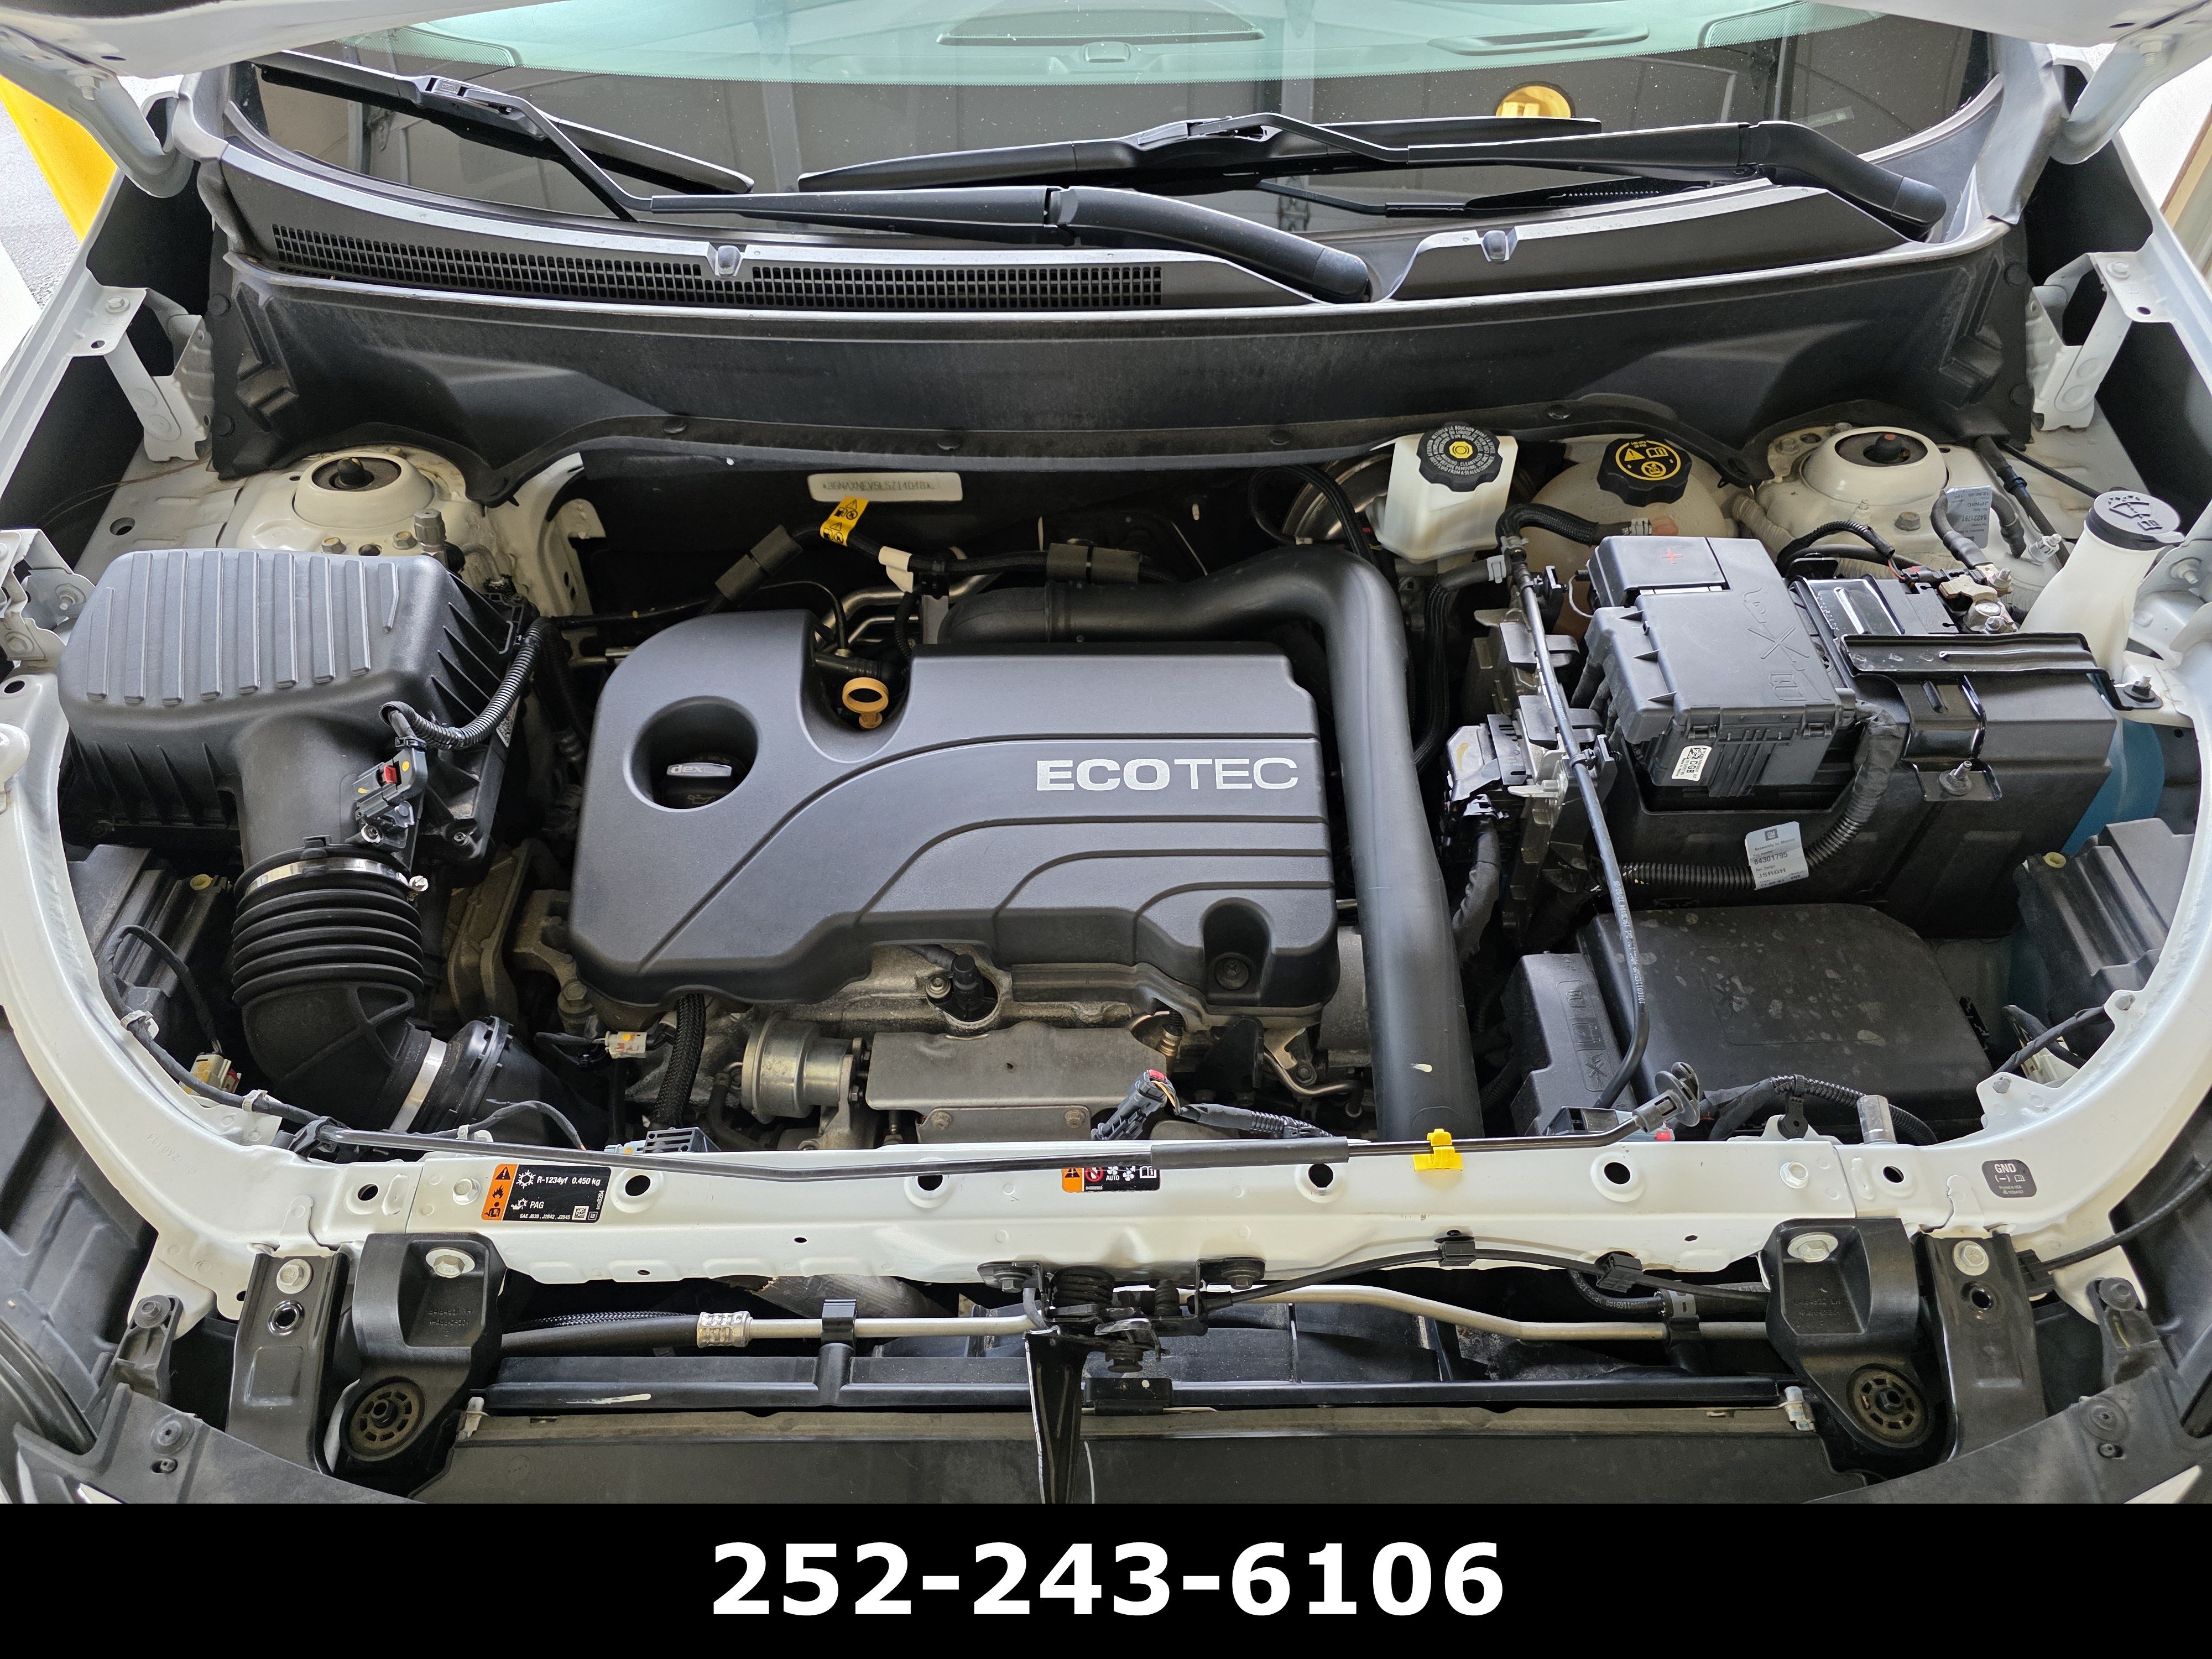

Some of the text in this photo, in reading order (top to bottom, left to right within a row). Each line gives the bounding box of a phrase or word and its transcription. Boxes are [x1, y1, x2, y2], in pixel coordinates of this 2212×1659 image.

[1036, 757, 1298, 792] ECOTEC
[1754, 852, 1788, 865] 84301795
[1758, 868, 1786, 879] JSRGH
[1994, 1163, 2017, 1173] GND
[536, 1176, 601, 1186] R-1234yf 0.450 kg
[529, 1201, 544, 1209] PAG
